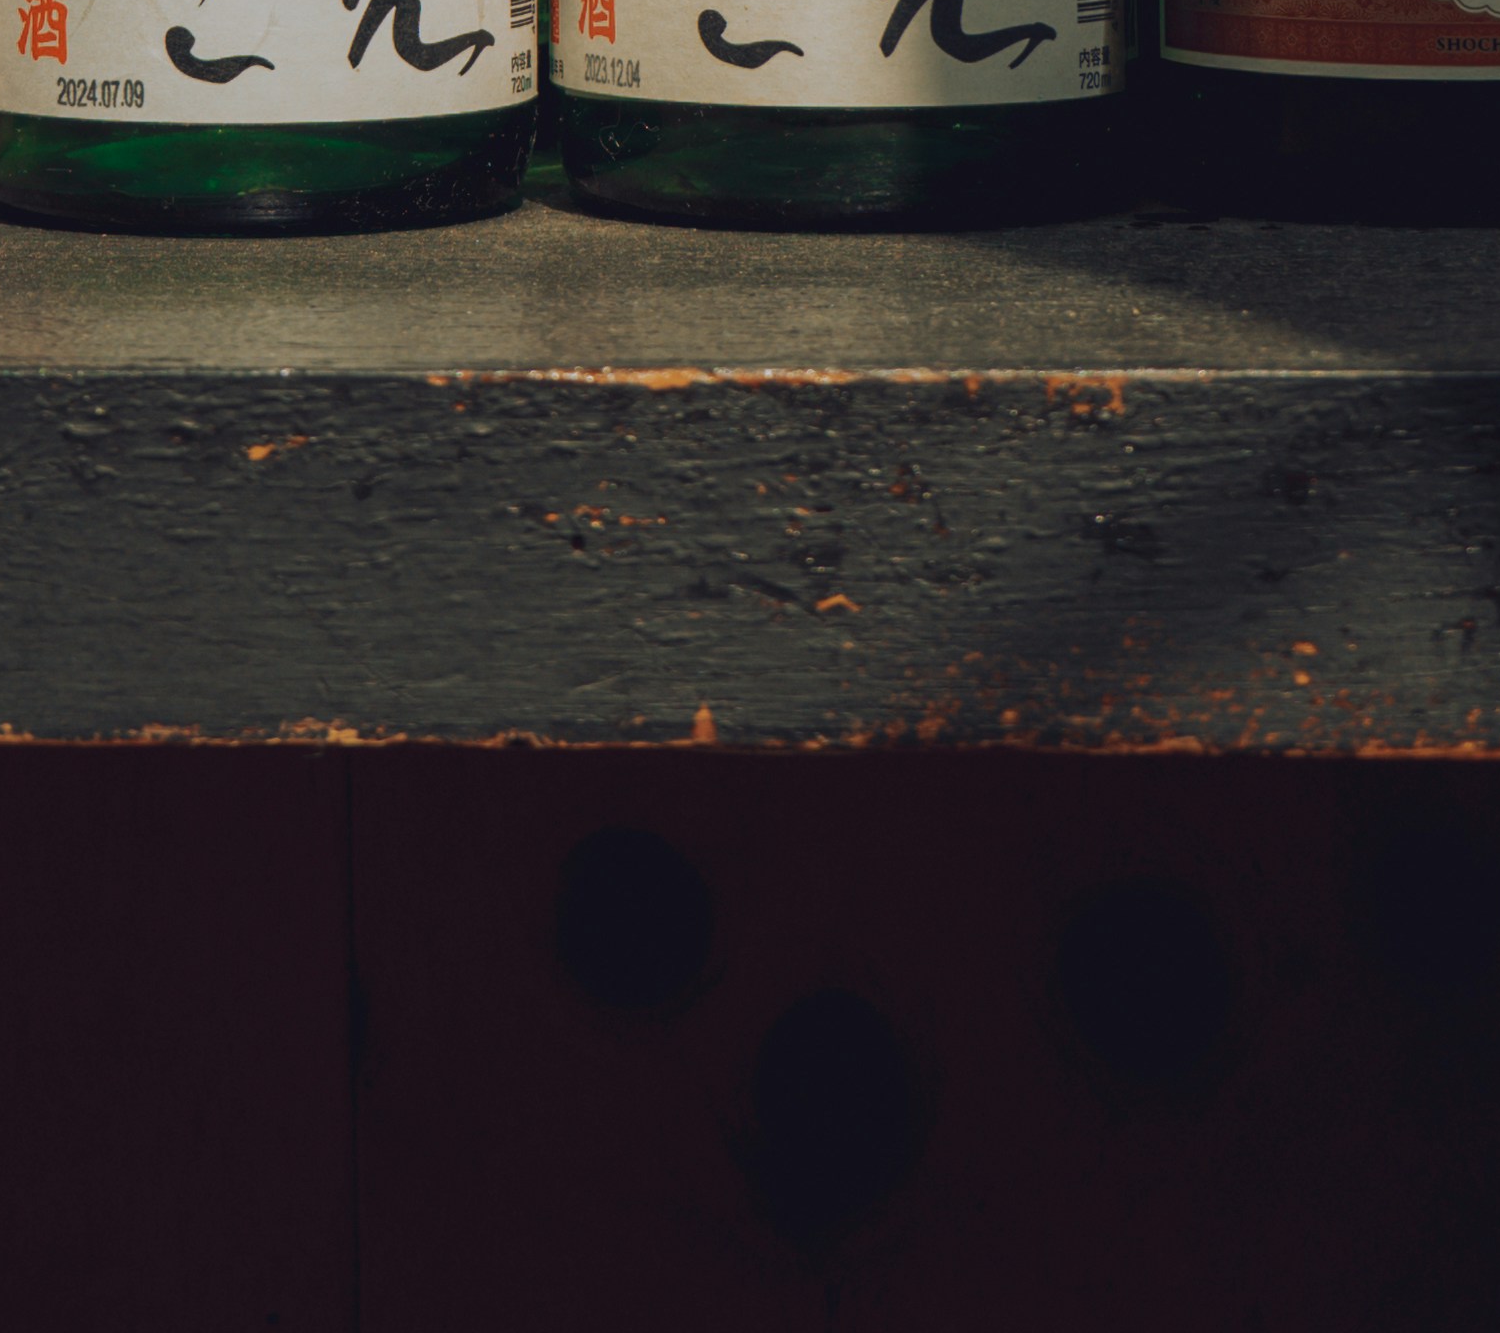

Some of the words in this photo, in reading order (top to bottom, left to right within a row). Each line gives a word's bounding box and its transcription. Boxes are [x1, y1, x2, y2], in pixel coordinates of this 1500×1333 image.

[511, 50, 532, 73] 内容量
[1078, 47, 1111, 68] 内容量
[583, 52, 642, 89] 2023.12.04
[1078, 70, 1112, 90] 720ml
[57, 77, 145, 109] 2024.07.09
